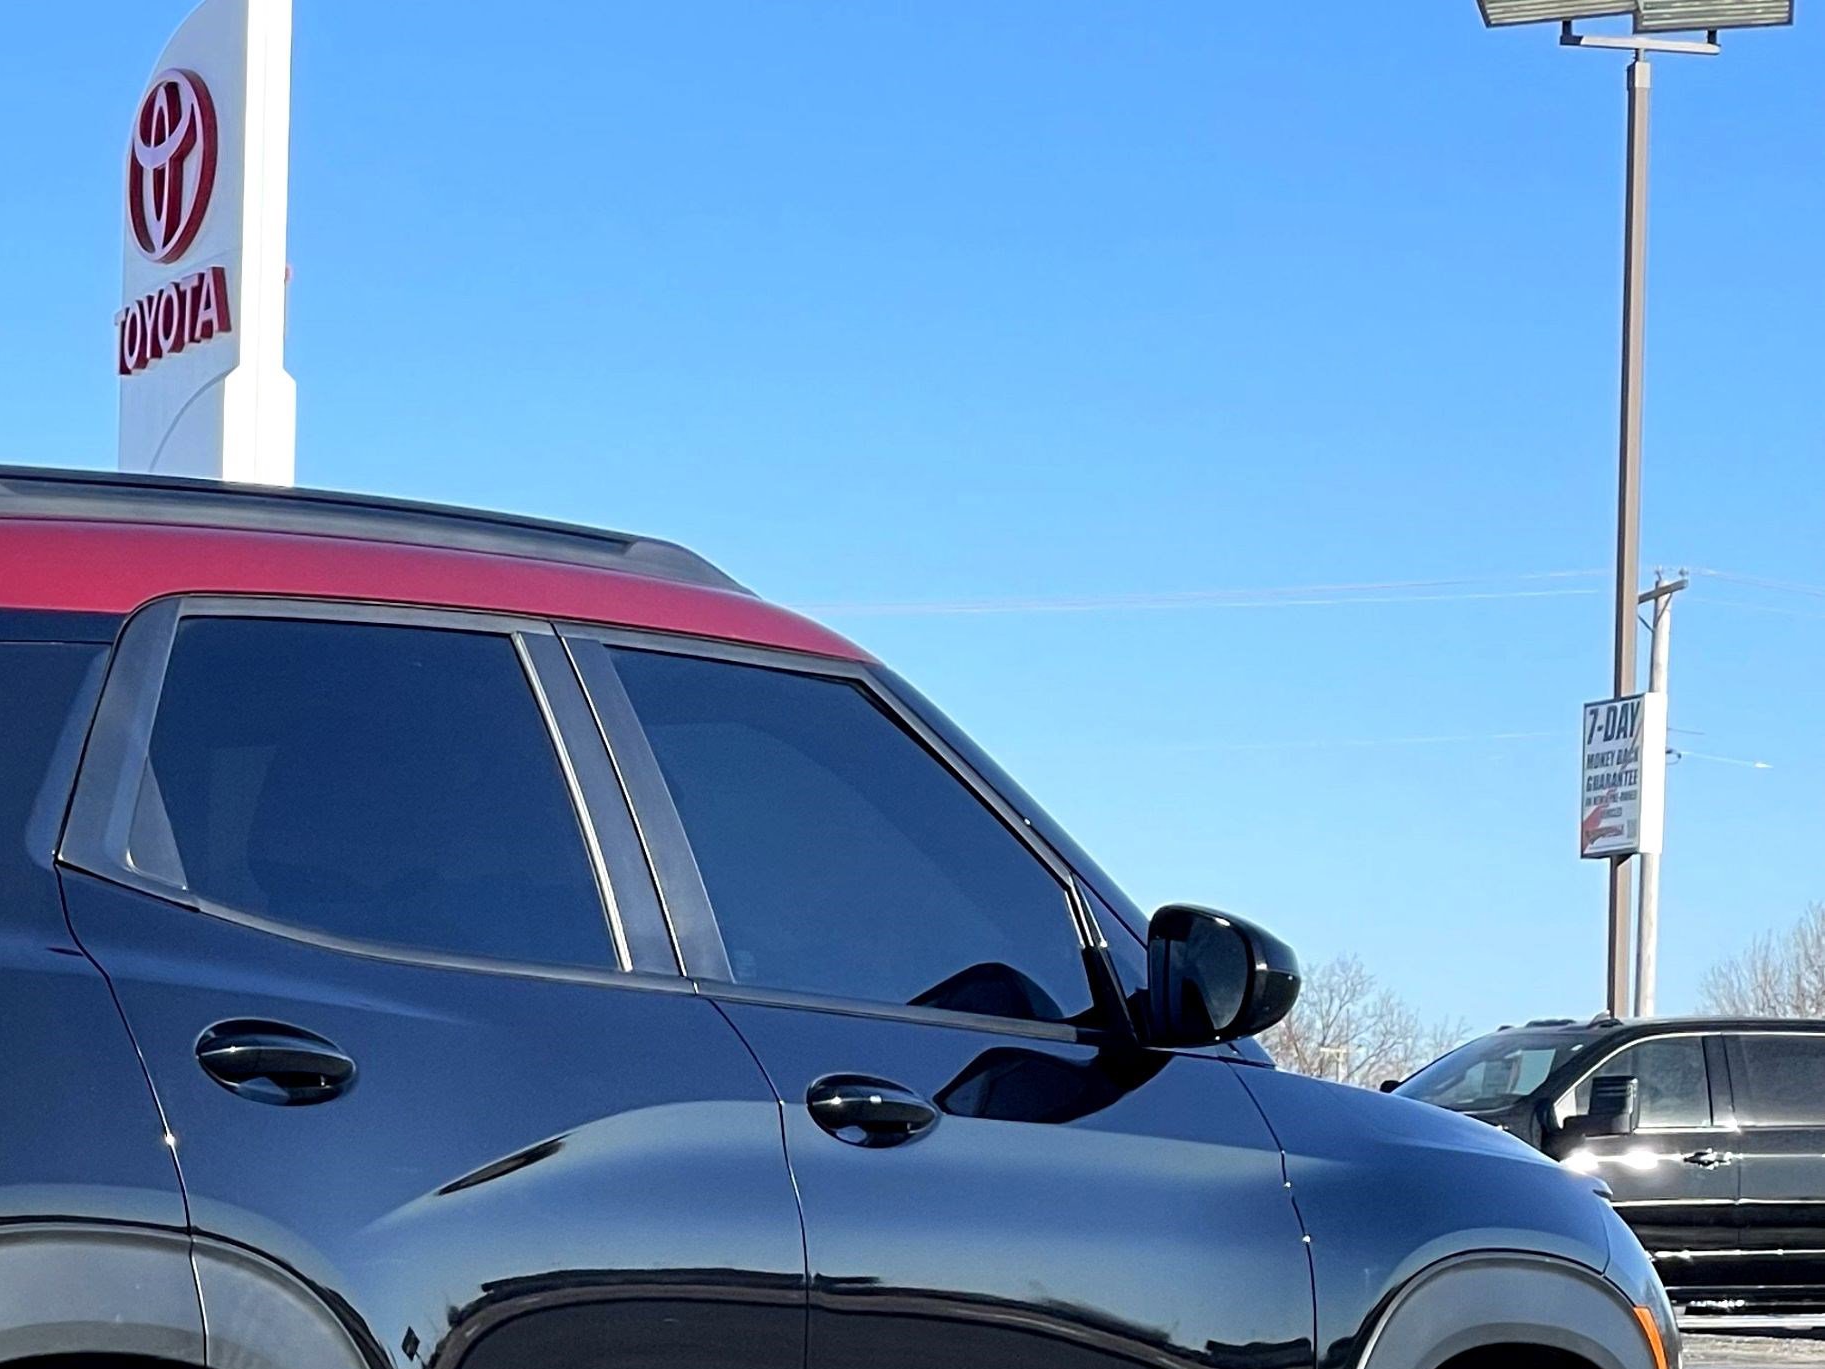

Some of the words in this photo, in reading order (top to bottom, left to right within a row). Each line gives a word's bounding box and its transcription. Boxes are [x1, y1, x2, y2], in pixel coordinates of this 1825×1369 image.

[114, 266, 231, 375] TOYOTA
[1587, 700, 1641, 745] 7-DAY
[1587, 749, 1614, 769] MONEY
[1617, 746, 1639, 766] BACK
[1586, 768, 1639, 792] GUARANTEE
